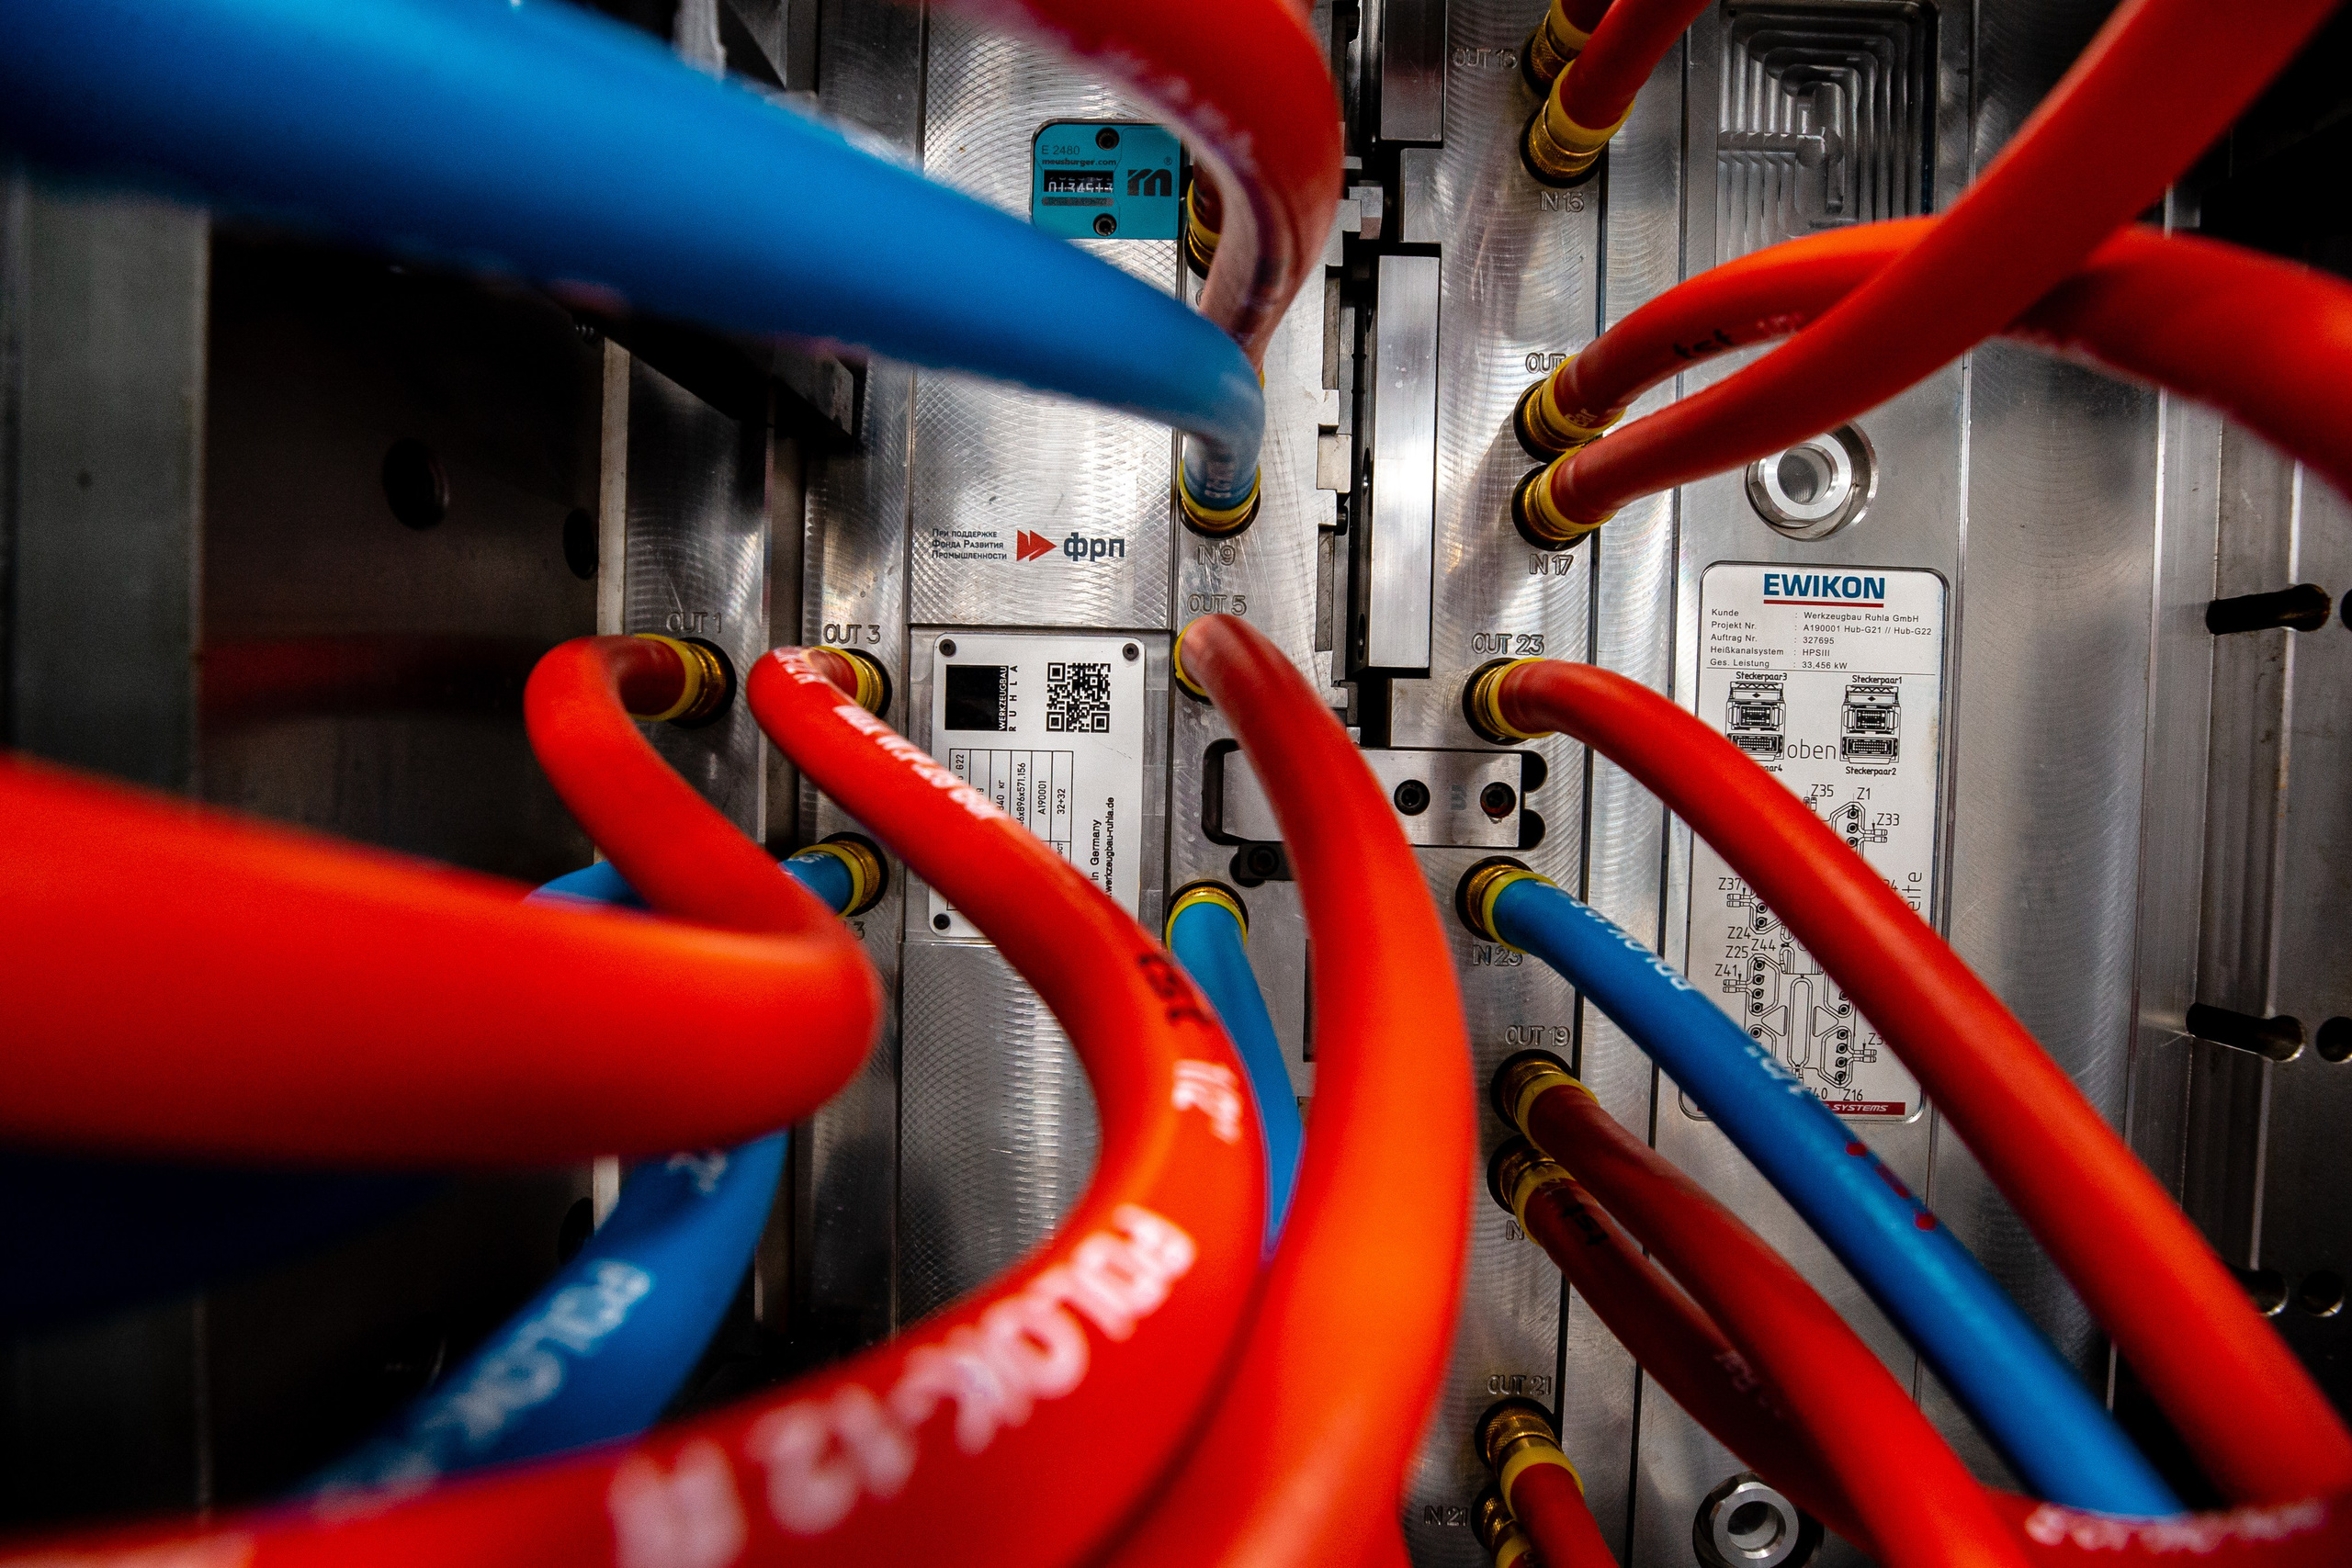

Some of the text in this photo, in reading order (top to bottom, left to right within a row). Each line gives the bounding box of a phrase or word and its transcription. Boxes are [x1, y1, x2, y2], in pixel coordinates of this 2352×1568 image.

[1452, 48, 1491, 68] OUT
[1041, 145, 1080, 154] E 2480
[1042, 158, 1117, 167] meusburger.com
[1563, 191, 1585, 213] 15
[1064, 532, 1125, 562] фрп
[1220, 545, 1237, 566] 9
[1551, 555, 1574, 576] 17
[1764, 573, 1885, 600] EWIKON
[1187, 593, 1248, 616] OUT 5
[665, 610, 723, 634] OUT 1
[1711, 608, 1920, 623] Kunde Werkzeugbau Ruhla GmbH
[823, 624, 881, 645] OUT 3
[1711, 621, 1742, 630] Projekt
[1744, 622, 1757, 630] Nr.
[1803, 624, 1840, 632] A190001
[1844, 625, 1882, 634] Hub-G21
[1894, 626, 1932, 636] Hub-G22
[1472, 632, 1545, 656] OUT 23
[1711, 634, 1835, 645] Auftrag Nr. 327695
[1711, 646, 1784, 657] Heißkanalsystem
[1710, 658, 1730, 667] Ges.
[1733, 660, 1770, 669] Leistung
[1736, 671, 1902, 685] Steckerpaar3 Steckerpaar1
[998, 666, 1007, 730] WERKZEUGBAU
[1786, 739, 1837, 761] oben
[956, 753, 965, 770] G22
[1845, 766, 1896, 777] Steckerpaar2
[1037, 781, 1047, 816] A190001
[1057, 788, 1066, 815] 32+32
[1811, 784, 1871, 801] Z35 Z1
[1877, 813, 1900, 827] Z33
[1090, 819, 1102, 866] Germany
[1104, 797, 1115, 900] .werkzeugbau-ruhla.de
[1718, 877, 1742, 891] Z37
[1727, 926, 1777, 952] Z24 Z44
[1725, 946, 1748, 959] Z25
[1714, 964, 1738, 977] Z41
[1505, 1025, 1571, 1047] OUT 19
[1843, 1089, 1863, 1101] Z16
[1832, 1104, 1889, 1112] SYSTEMS
[1487, 1374, 1552, 1396] OUT 21
[1446, 1506, 1469, 1527] 21
